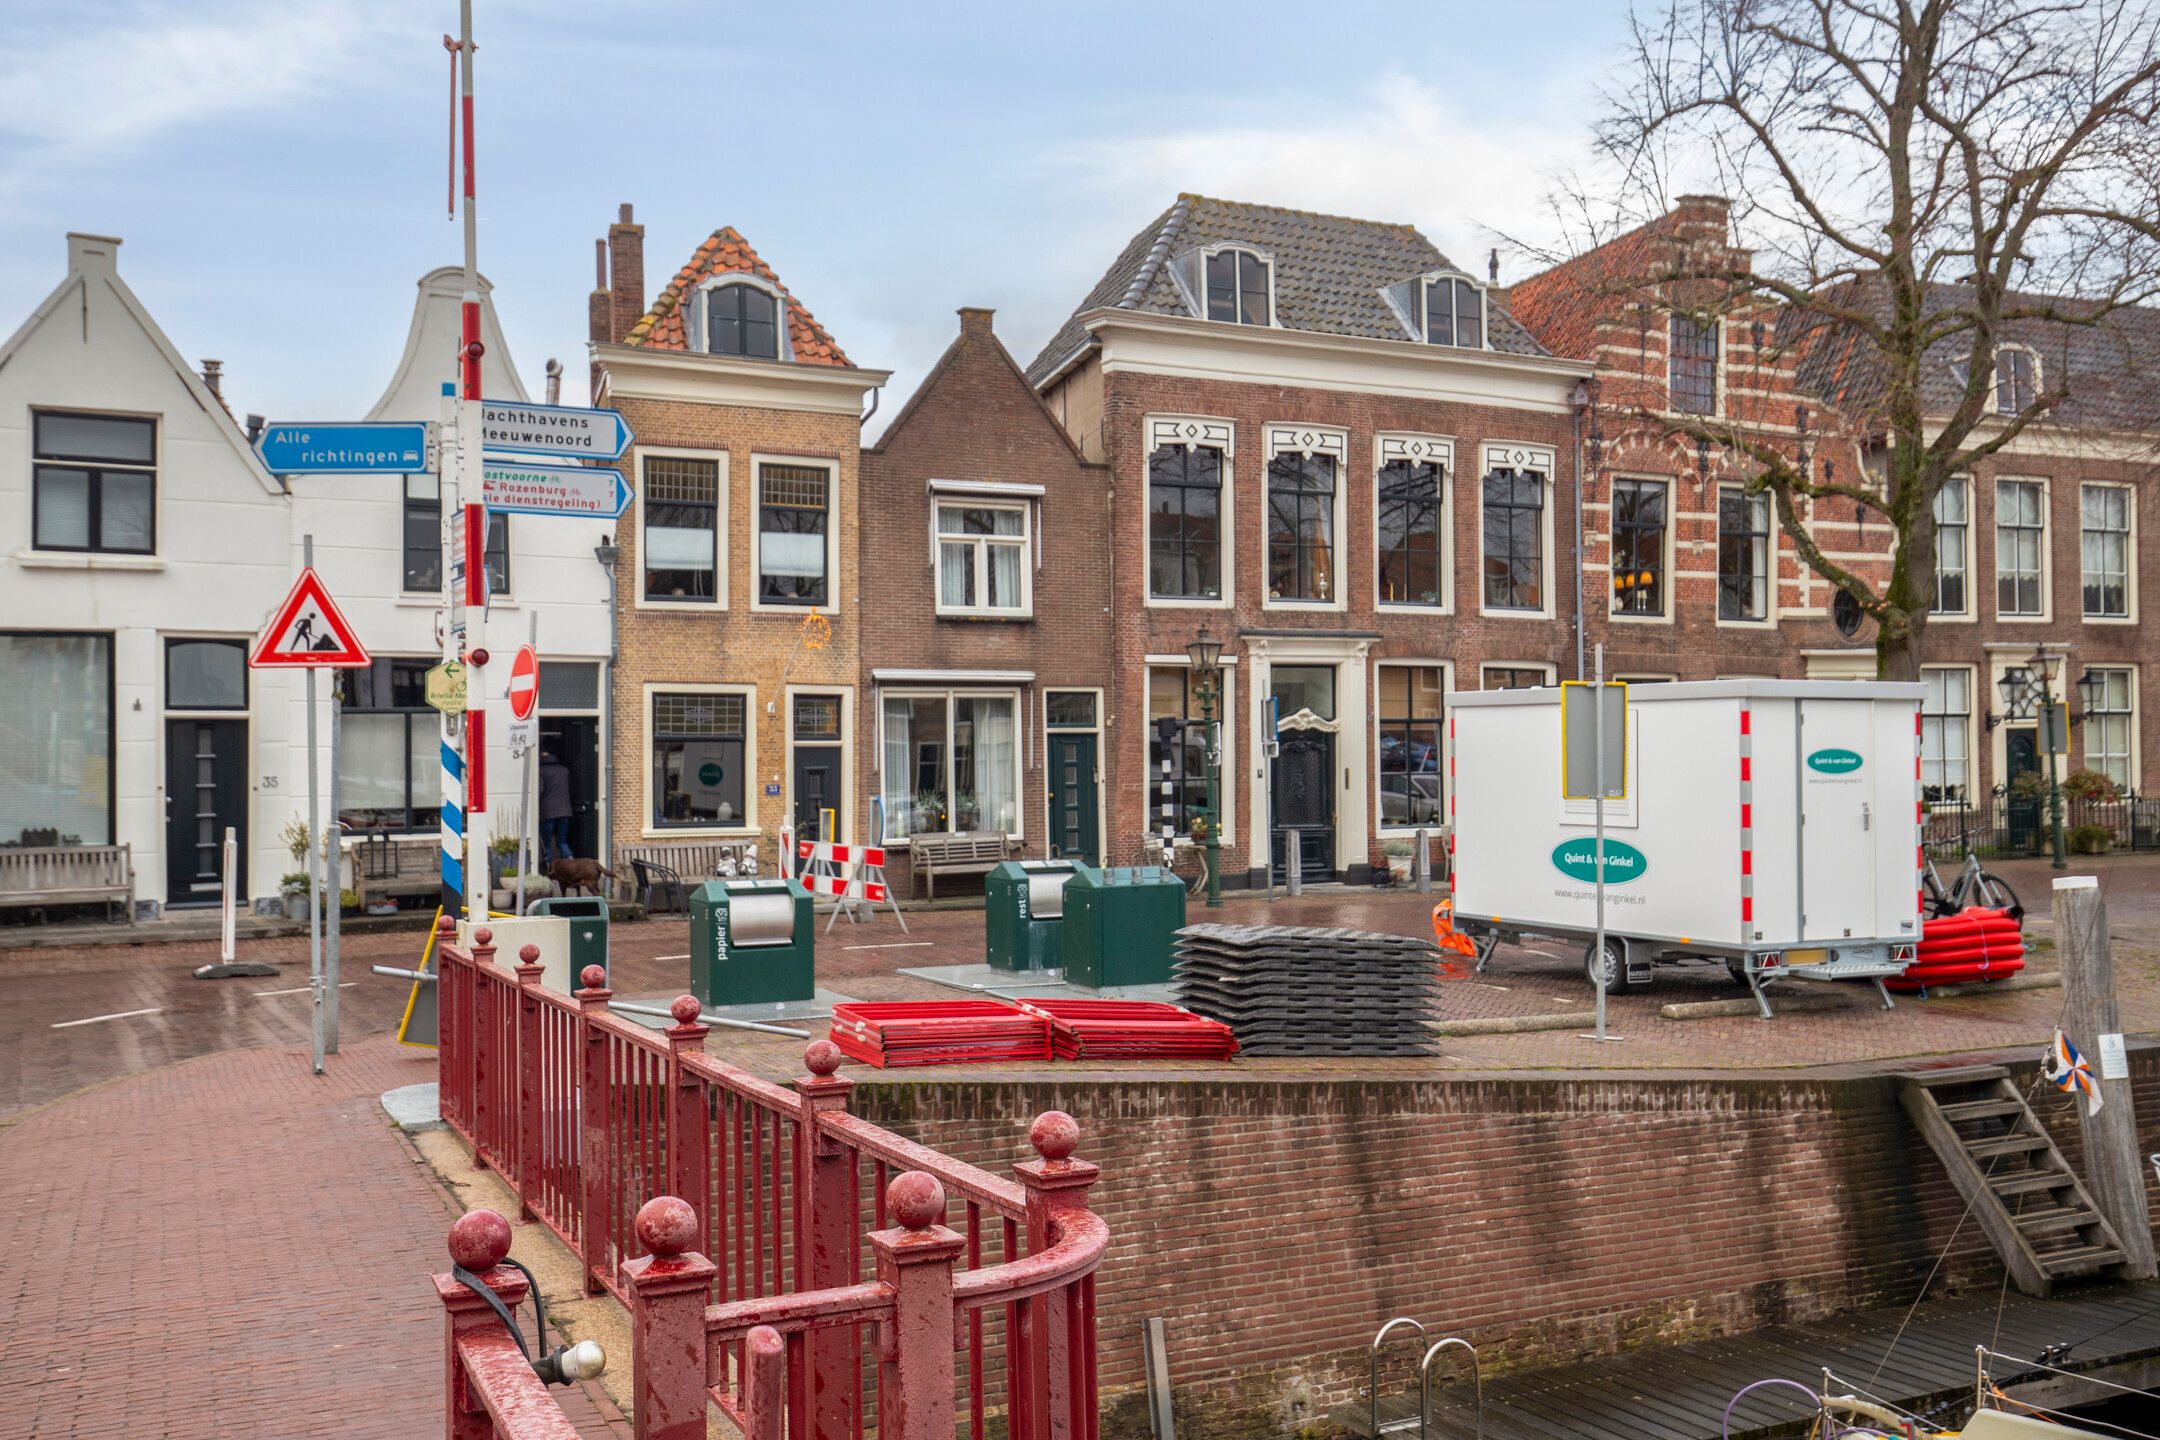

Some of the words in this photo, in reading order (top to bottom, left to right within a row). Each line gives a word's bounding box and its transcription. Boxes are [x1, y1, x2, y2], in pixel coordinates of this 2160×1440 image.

[274, 431, 311, 445] Alle
[302, 450, 398, 465] richtingen
[484, 469, 547, 483] ostvoorne
[500, 482, 566, 497] Rozenburg
[504, 495, 601, 510] dienstregeling)
[262, 775, 279, 788] 35
[1564, 852, 1586, 865] Quint
[1586, 854, 1593, 864] &
[1609, 855, 1634, 867] Ginkel
[1554, 888, 1646, 905] www.quintevanginkel.nl
[1018, 899, 1026, 919] rest
[716, 926, 728, 960] papier
